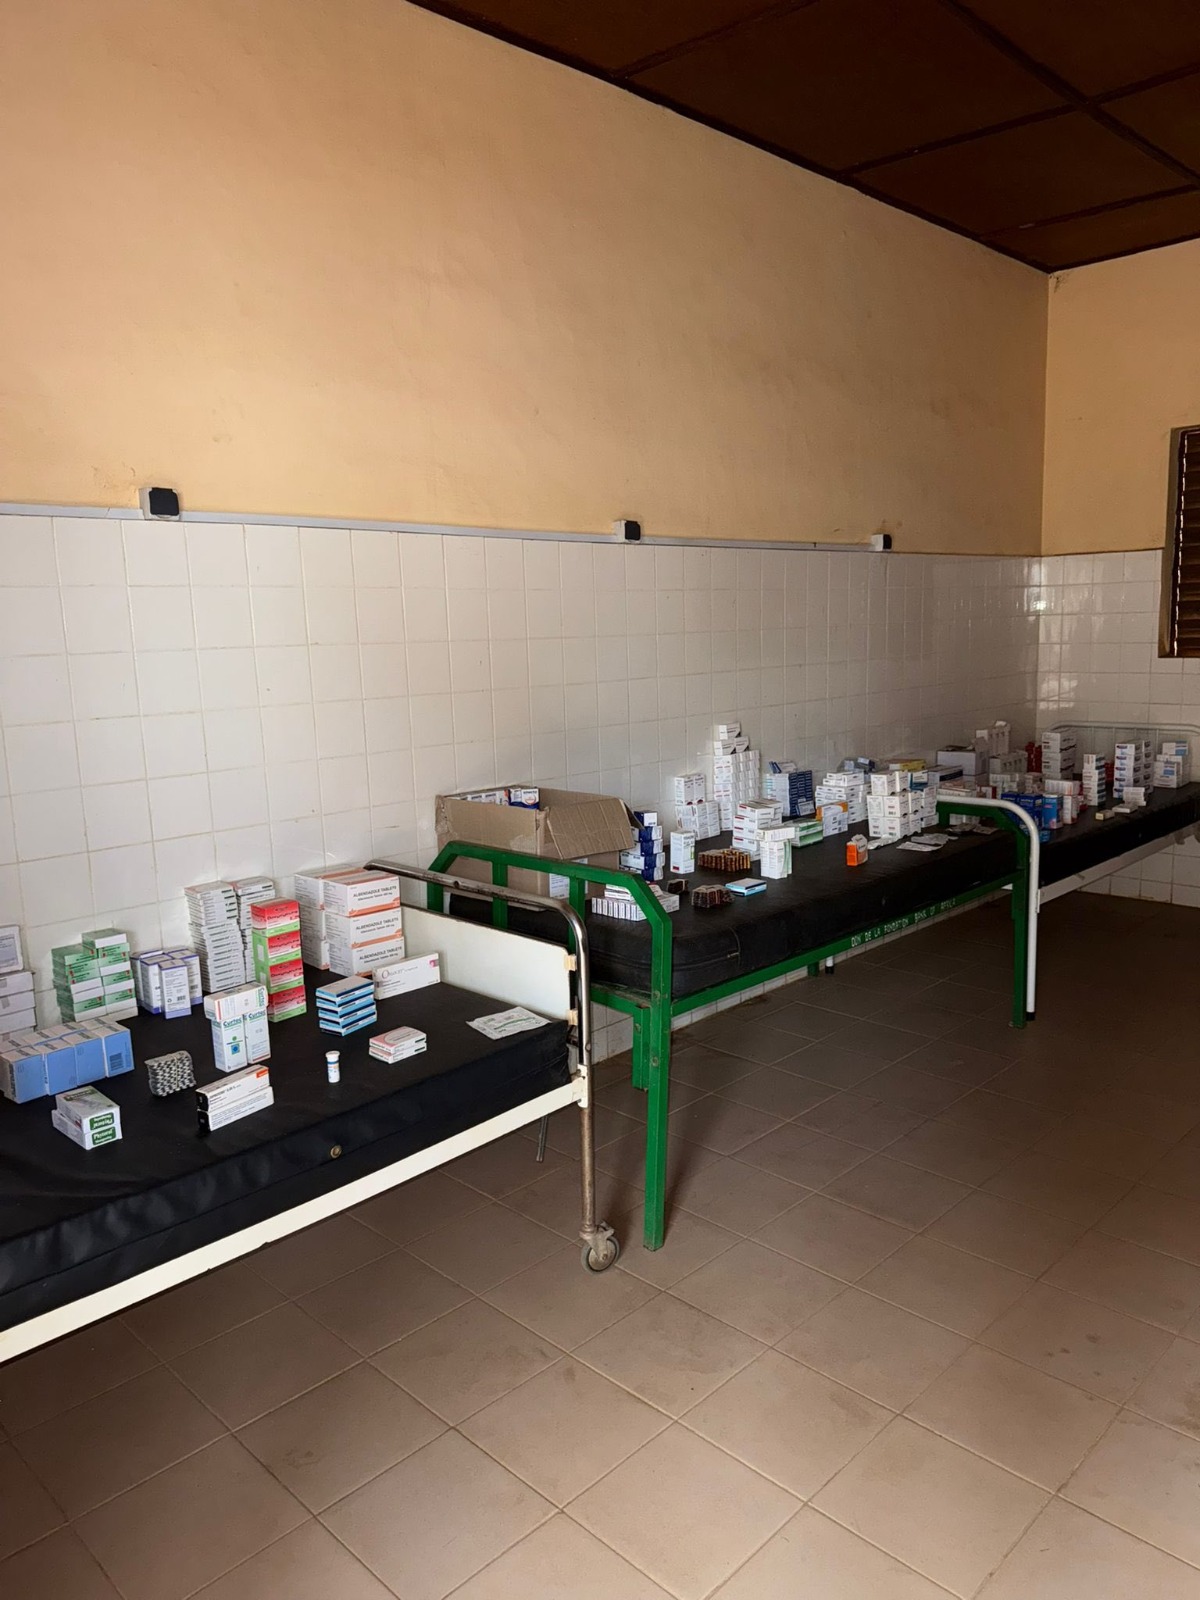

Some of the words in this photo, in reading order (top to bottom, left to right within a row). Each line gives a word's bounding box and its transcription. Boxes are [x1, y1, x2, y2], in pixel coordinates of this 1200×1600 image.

[353, 889, 380, 897] ALBENDAZOLE
[356, 920, 382, 930] ALBENDAZOLE
[865, 932, 872, 941] DE
[874, 928, 881, 937] LA
[359, 950, 386, 961] ALBENDAZOLE
[387, 946, 402, 954] TABLETS
